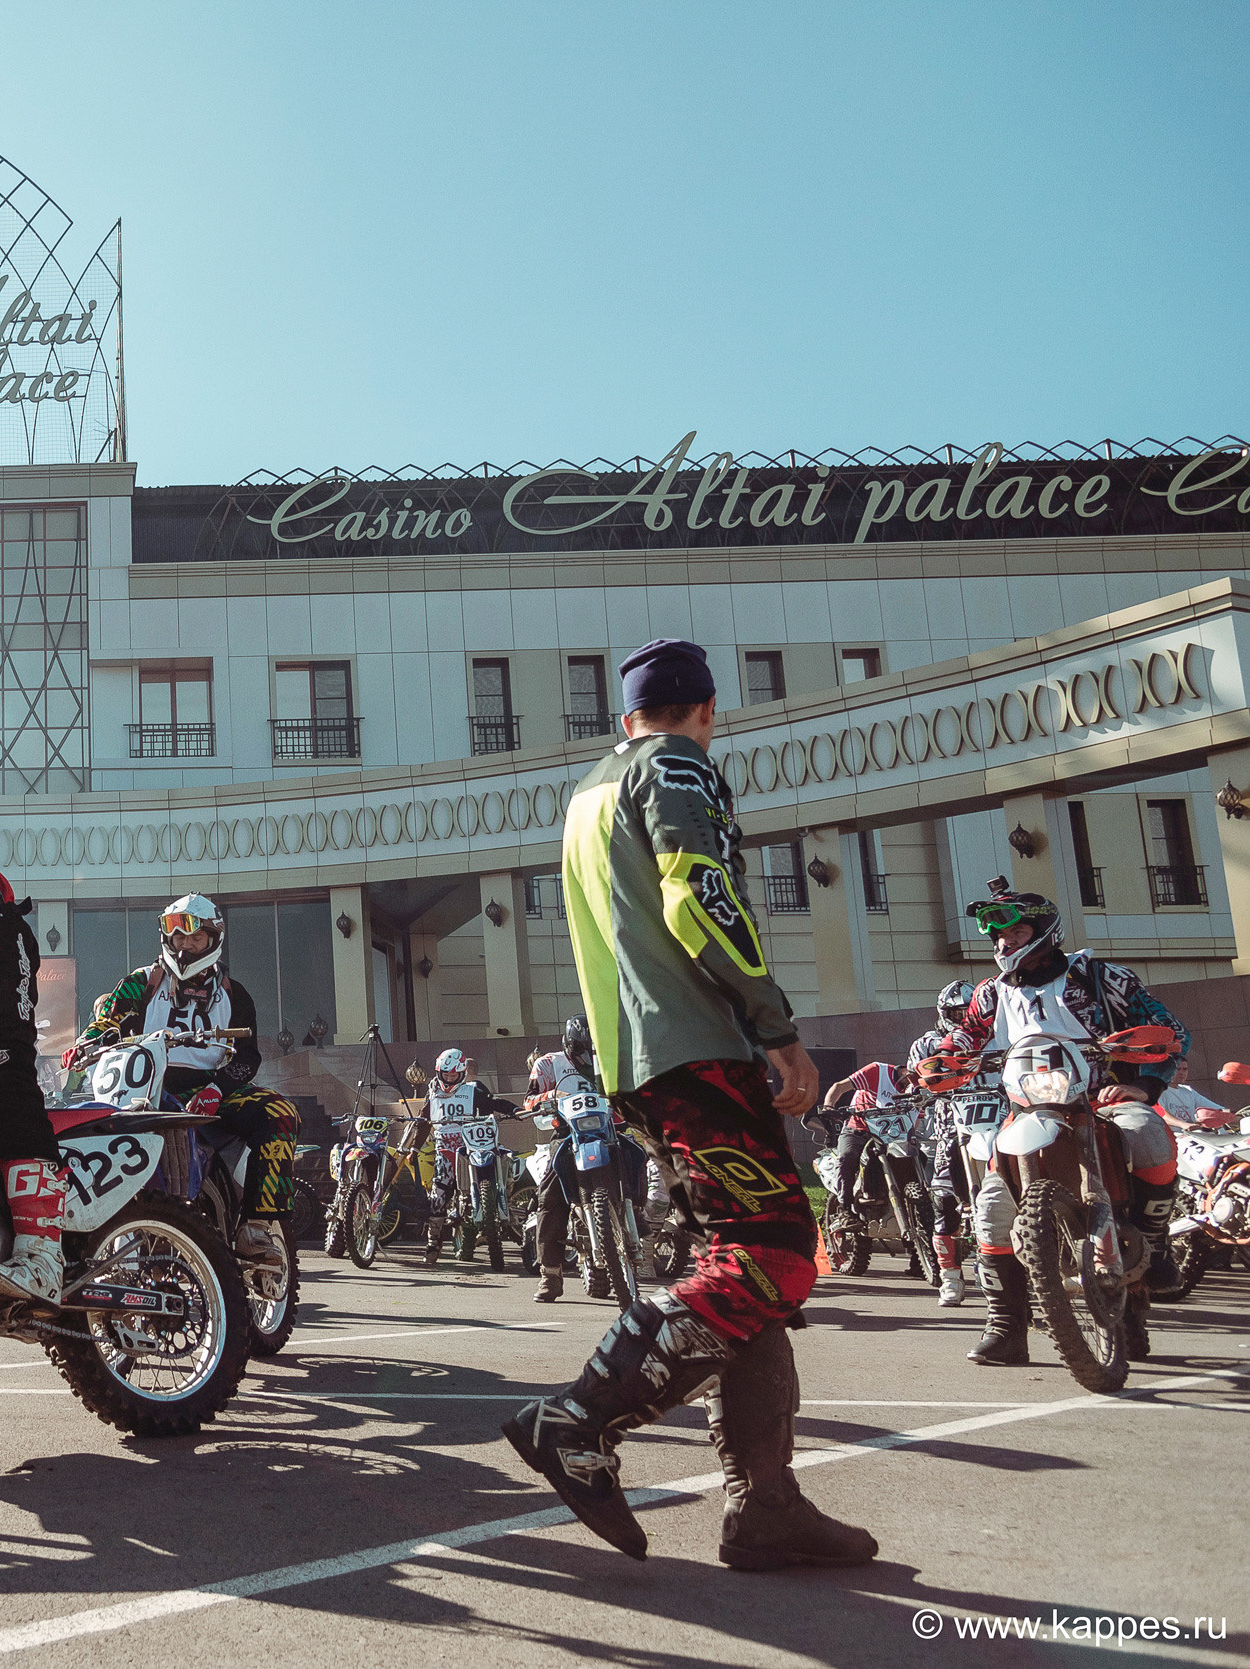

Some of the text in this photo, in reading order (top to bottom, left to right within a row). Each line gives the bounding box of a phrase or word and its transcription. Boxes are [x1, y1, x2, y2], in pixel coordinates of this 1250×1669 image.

[247, 474, 473, 544] Casino
[502, 430, 827, 536] Altai
[854, 441, 1111, 544] palace
[167, 1007, 212, 1033] 50
[97, 1049, 154, 1095] 50
[439, 1103, 465, 1116] 109
[571, 1095, 598, 1112] 58
[358, 1118, 384, 1131] 106
[963, 1103, 1000, 1126] 10
[468, 1126, 496, 1139] 109
[875, 1117, 907, 1137] 21
[67, 1135, 150, 1207] 123
[121, 1293, 157, 1306] AMSOIL
